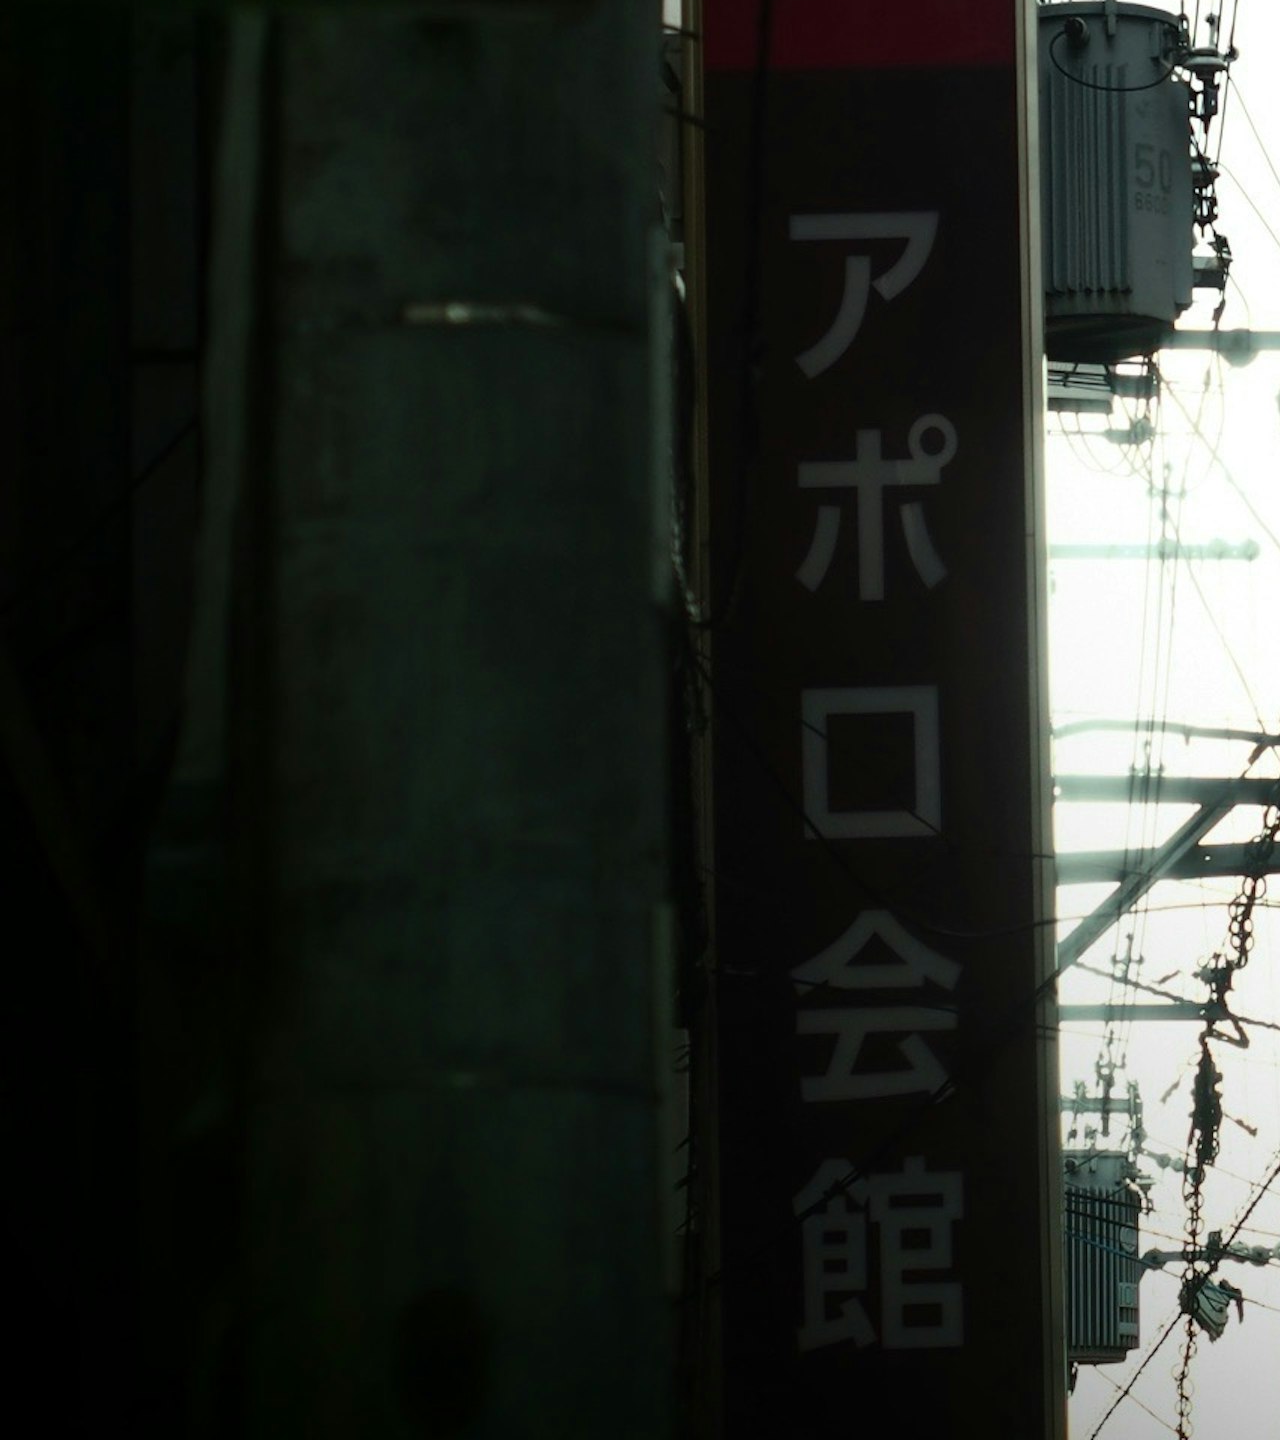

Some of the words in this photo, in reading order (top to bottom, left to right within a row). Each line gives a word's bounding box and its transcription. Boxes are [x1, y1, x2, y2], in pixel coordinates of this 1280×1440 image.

[789, 210, 964, 1352] アポロ会館
